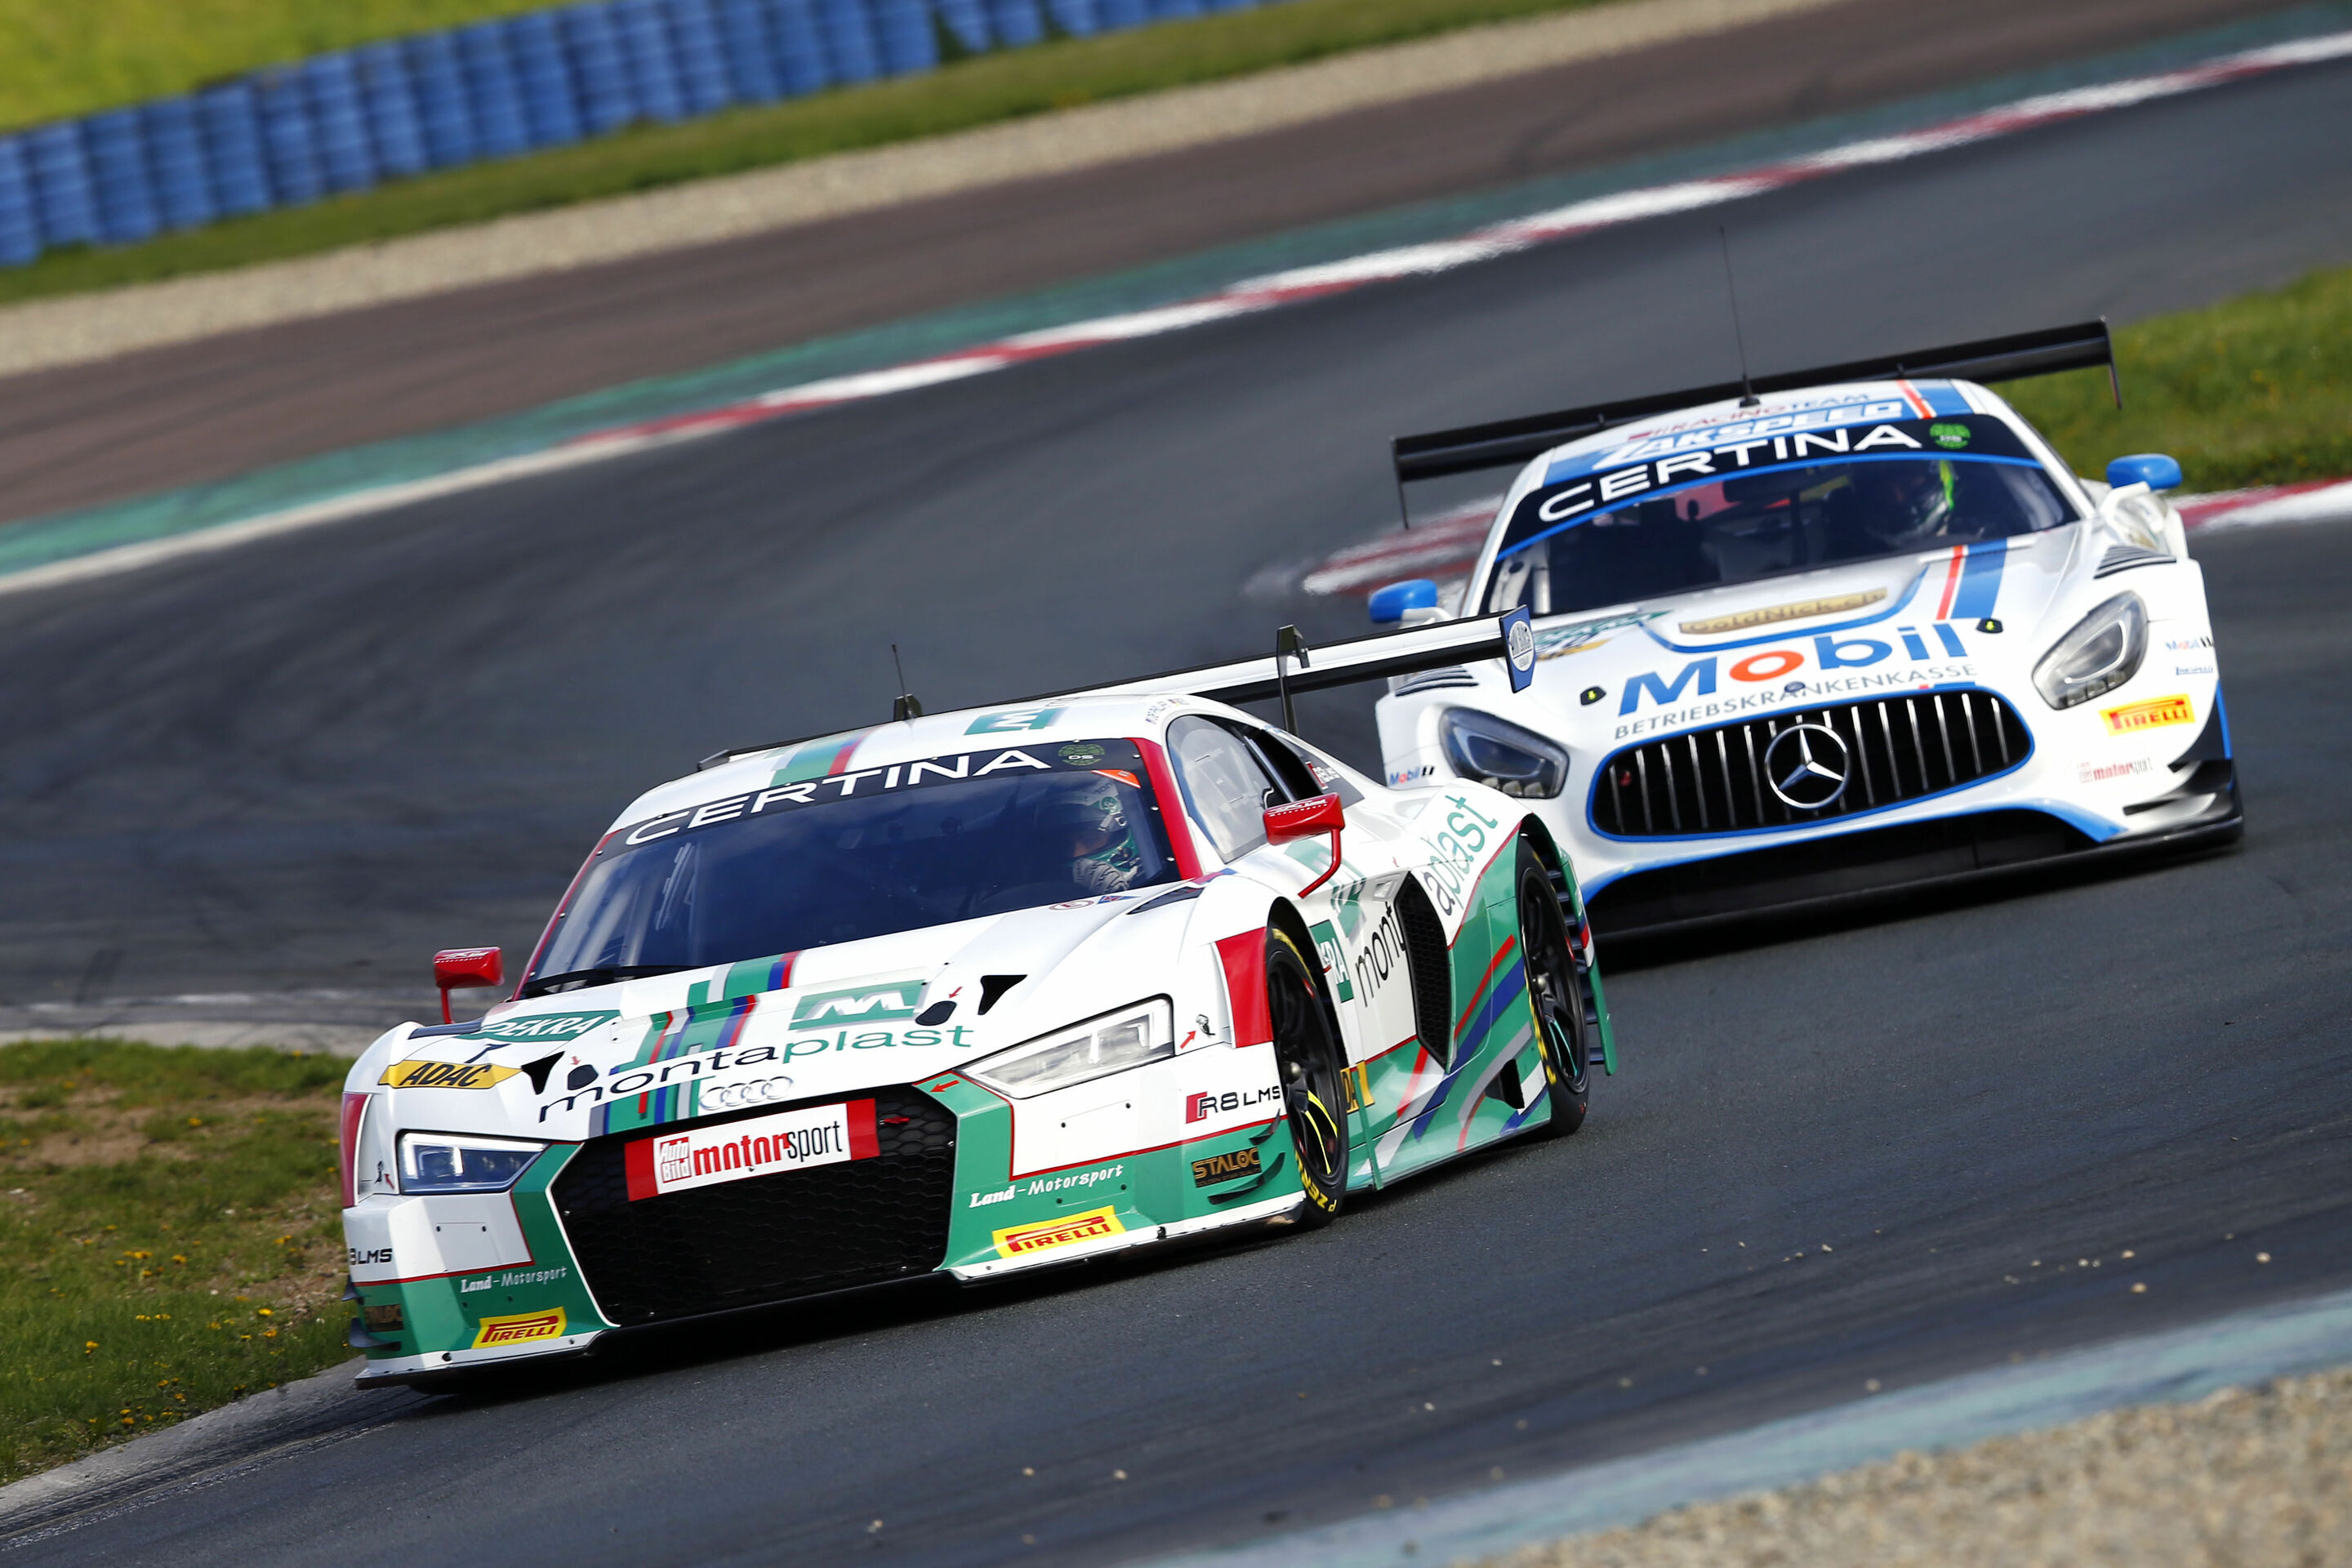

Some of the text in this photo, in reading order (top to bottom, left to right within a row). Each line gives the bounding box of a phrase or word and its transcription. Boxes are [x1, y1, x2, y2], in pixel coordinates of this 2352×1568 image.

[1592, 399, 1903, 471] ZAKSPEED
[1538, 424, 1922, 522] CERTINA
[1618, 623, 1968, 717] Mobil
[1614, 663, 1978, 740] BETRIEBSKRANKENKASSE
[2109, 698, 2189, 729] PIRELLI
[625, 749, 1052, 846] CERTINA
[481, 1015, 605, 1037] DEKRA
[400, 1062, 492, 1087] ADAC
[539, 1025, 973, 1123] montaplast
[1198, 1085, 1281, 1113] R8 LMS
[693, 1121, 843, 1176] motorsport
[1192, 1147, 1261, 1179] STALOC
[662, 1158, 691, 1182] Bild
[969, 1163, 1124, 1209] Land-Motorsport
[1005, 1215, 1112, 1253] PIRELLI
[358, 1248, 393, 1265] LMS
[461, 1266, 567, 1294] Land-Motorsport
[481, 1315, 559, 1344] PIRELLI
